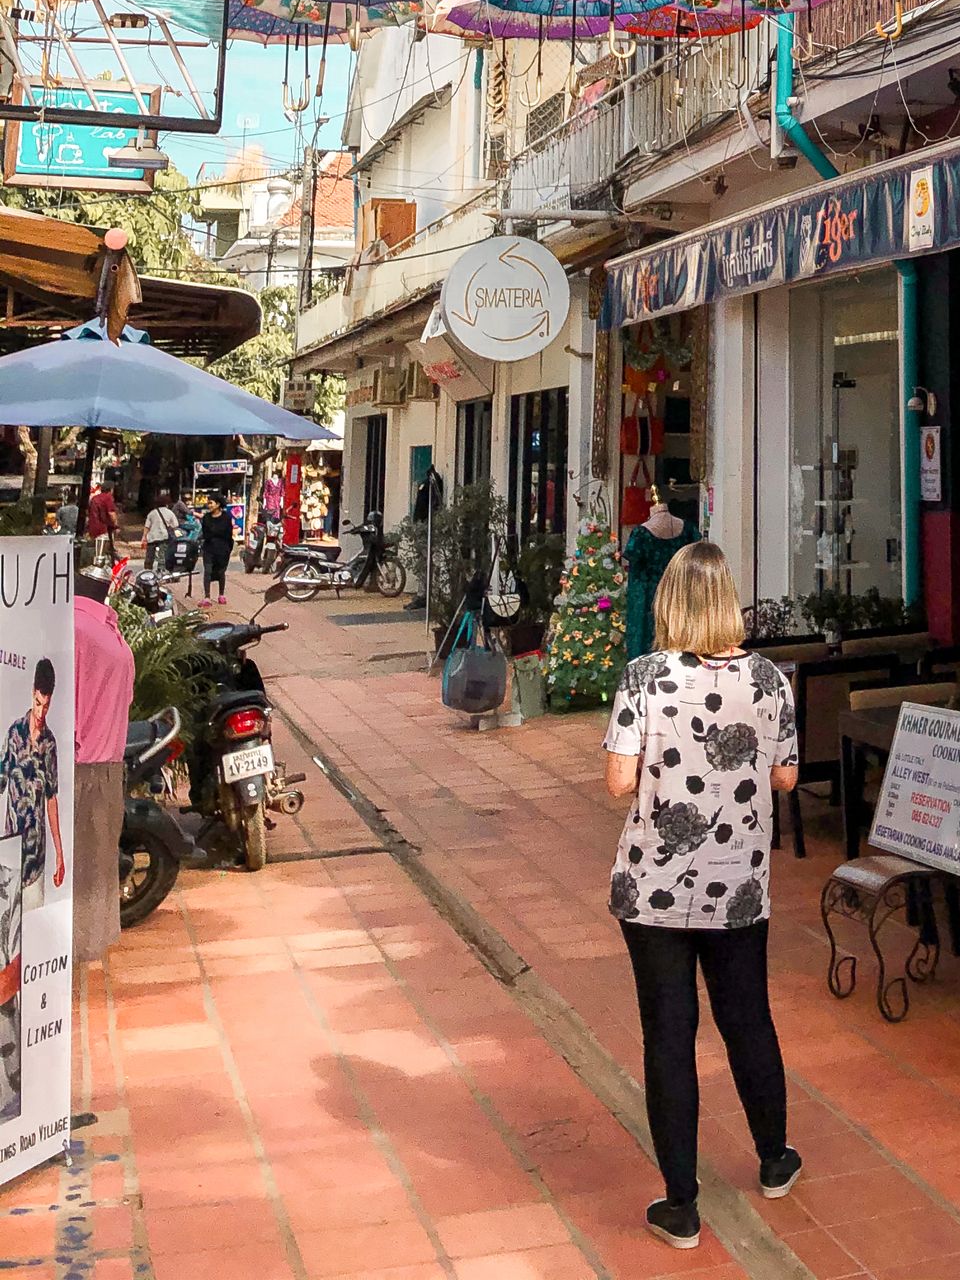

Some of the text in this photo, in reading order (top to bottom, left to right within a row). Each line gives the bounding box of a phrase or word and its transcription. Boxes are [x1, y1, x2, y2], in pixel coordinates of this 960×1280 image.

[816, 198, 859, 263] Tiger
[475, 287, 544, 308] SMATERIA
[0, 552, 70, 608] USH
[900, 713, 928, 735] KHMER
[891, 765, 930, 784] ALLEY WEST
[910, 791, 952, 813] RESERVATION
[874, 824, 904, 843] VEGETARIAN
[903, 832, 926, 850] COOKING
[926, 840, 943, 856] CLASS
[22, 953, 68, 985] COTTON
[40, 993, 47, 1010] &
[26, 1018, 63, 1048] LINEN
[39, 1116, 69, 1142] VILLAGE
